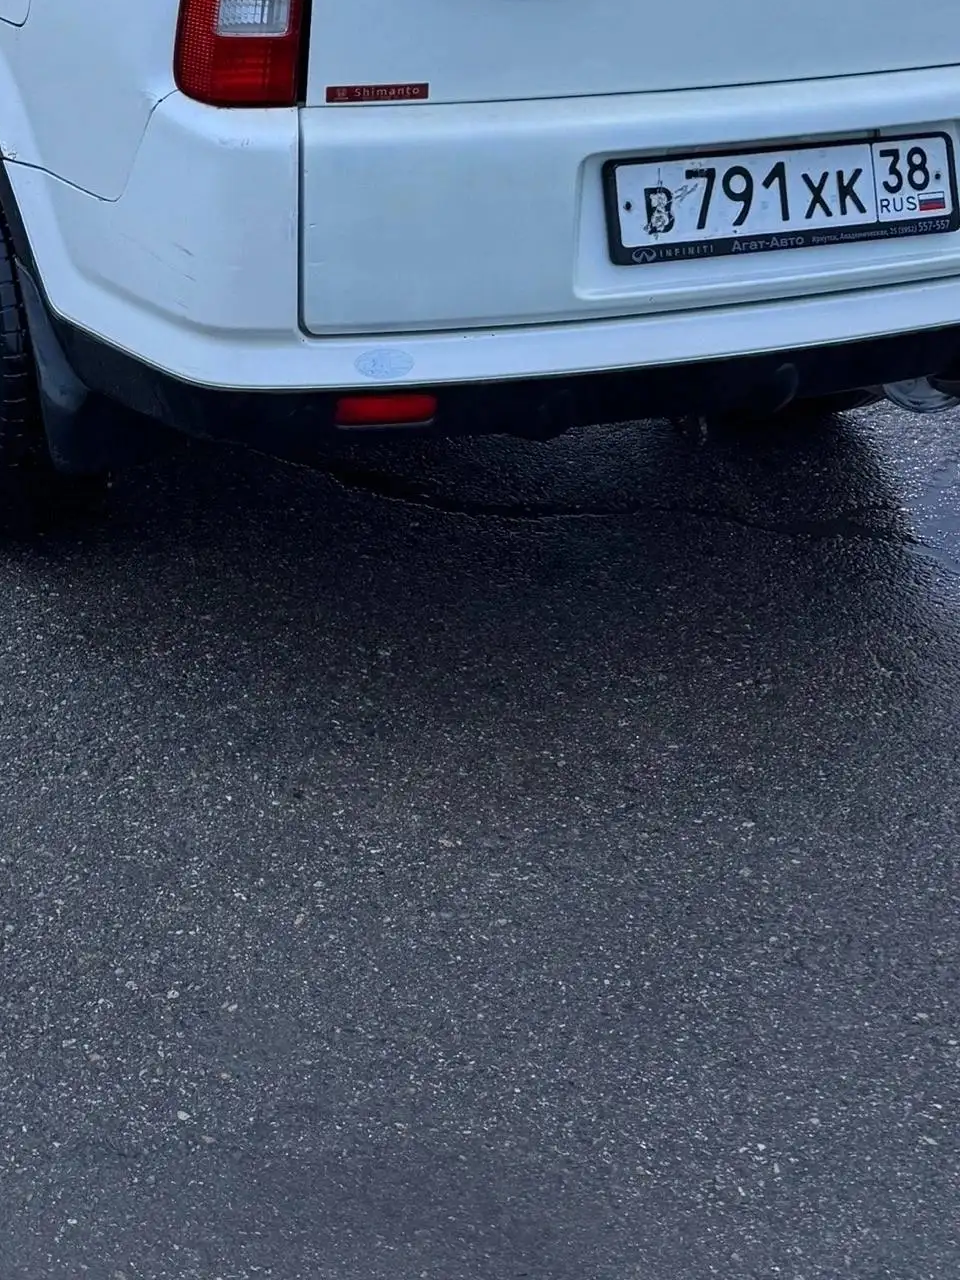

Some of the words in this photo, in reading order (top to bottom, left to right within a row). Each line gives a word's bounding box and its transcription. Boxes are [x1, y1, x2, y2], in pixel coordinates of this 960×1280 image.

[879, 146, 930, 194] 38
[880, 195, 918, 214] RUS
[659, 244, 714, 258] INFINITI
[918, 219, 950, 233] 557-557
